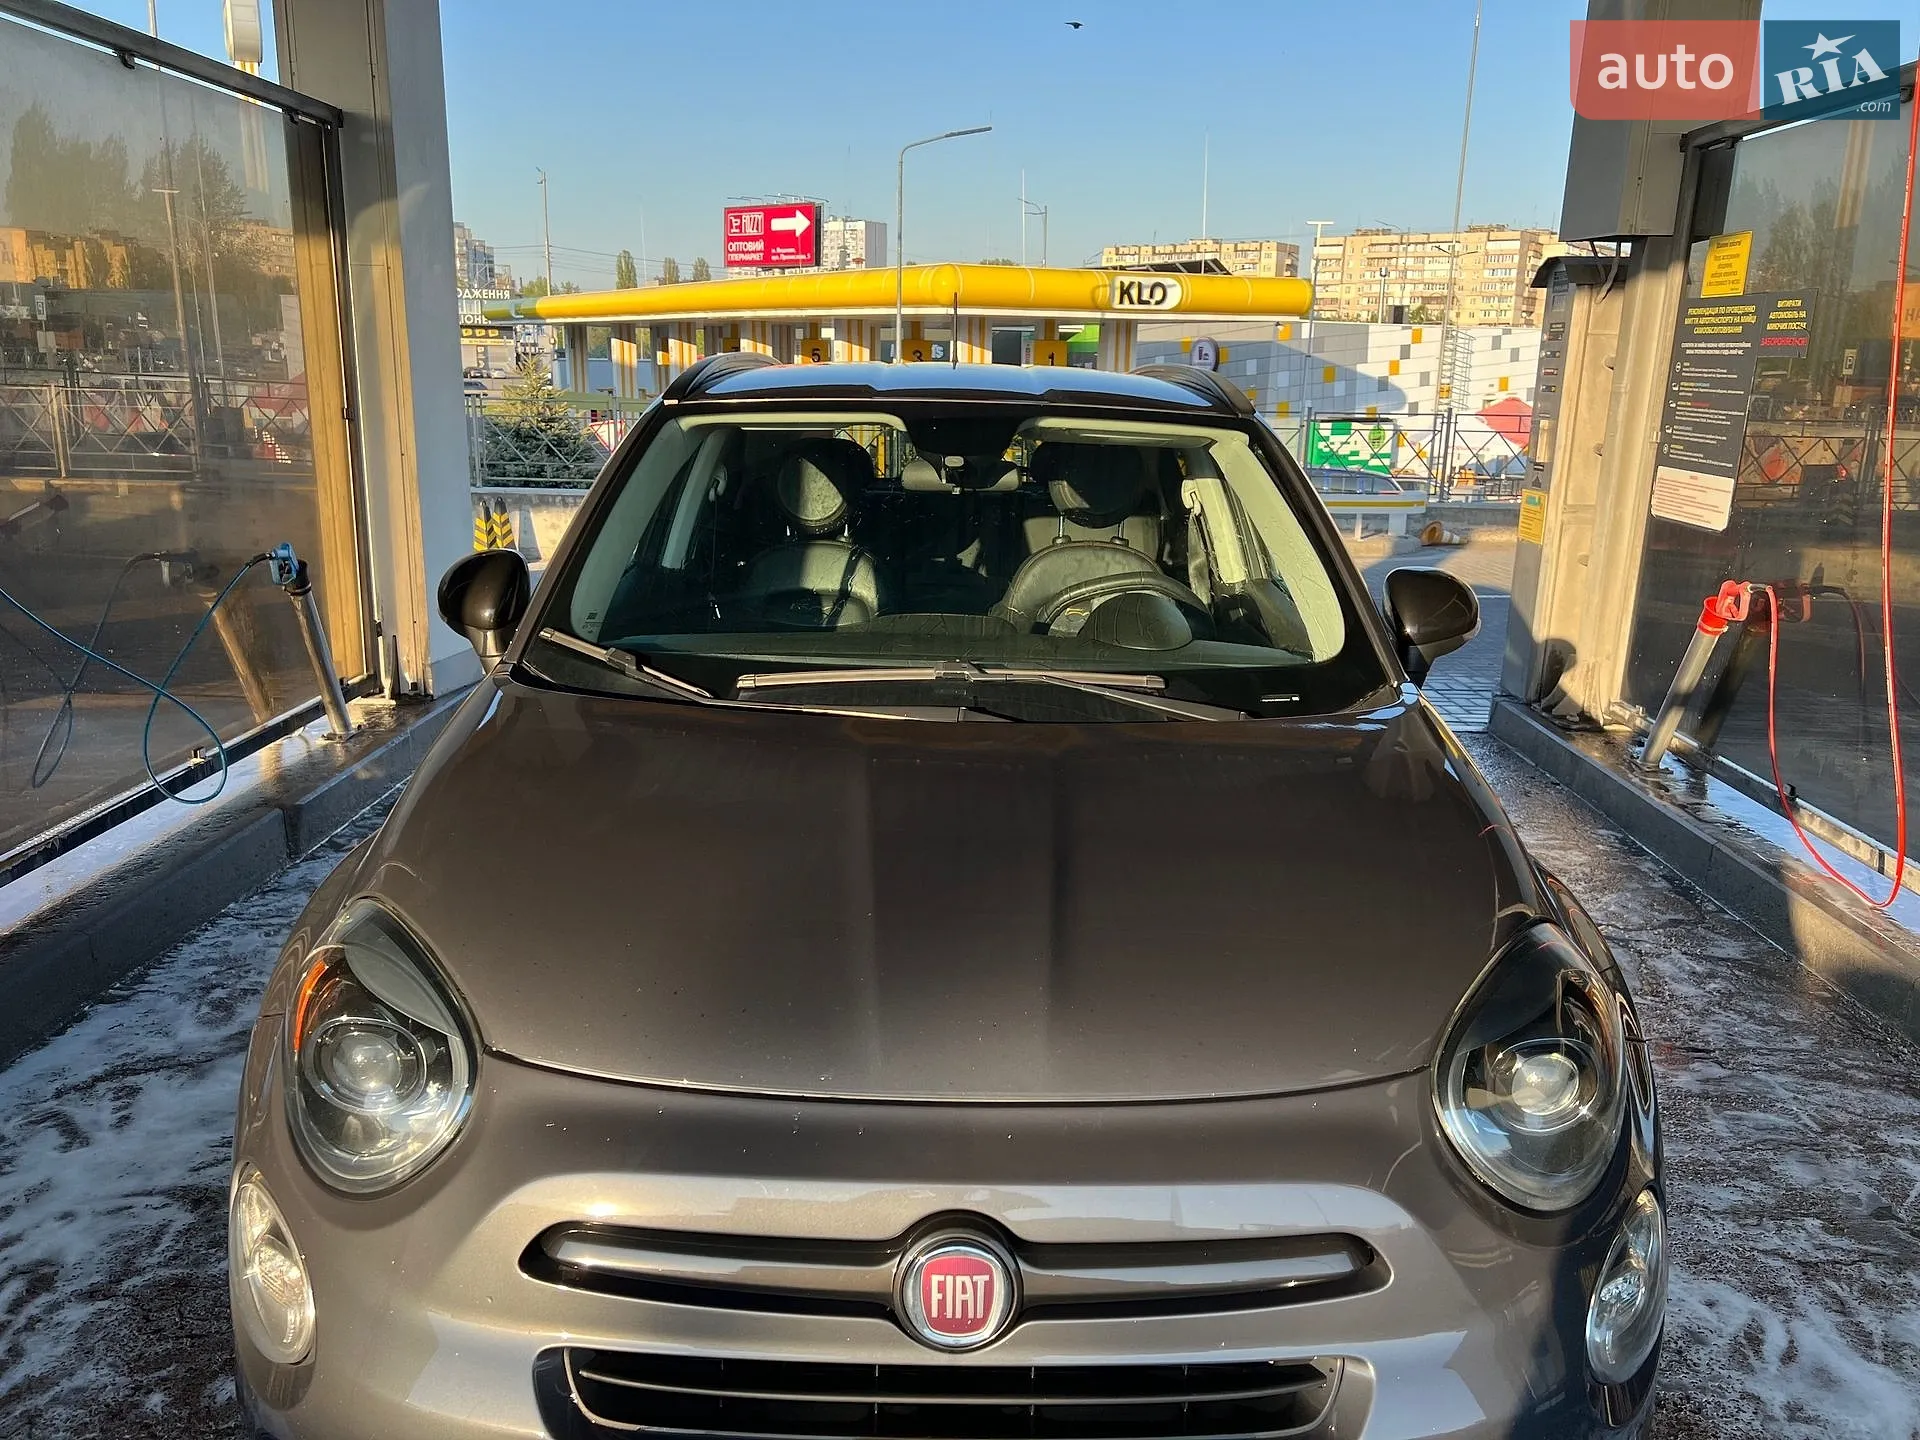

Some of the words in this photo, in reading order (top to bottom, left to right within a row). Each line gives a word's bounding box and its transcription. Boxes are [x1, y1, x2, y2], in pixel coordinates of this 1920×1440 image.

[742, 213, 763, 233] FOZZY
[727, 239, 765, 253] ОПТОВИЙ
[1119, 281, 1168, 305] KLO
[931, 1274, 990, 1319] FIAT
